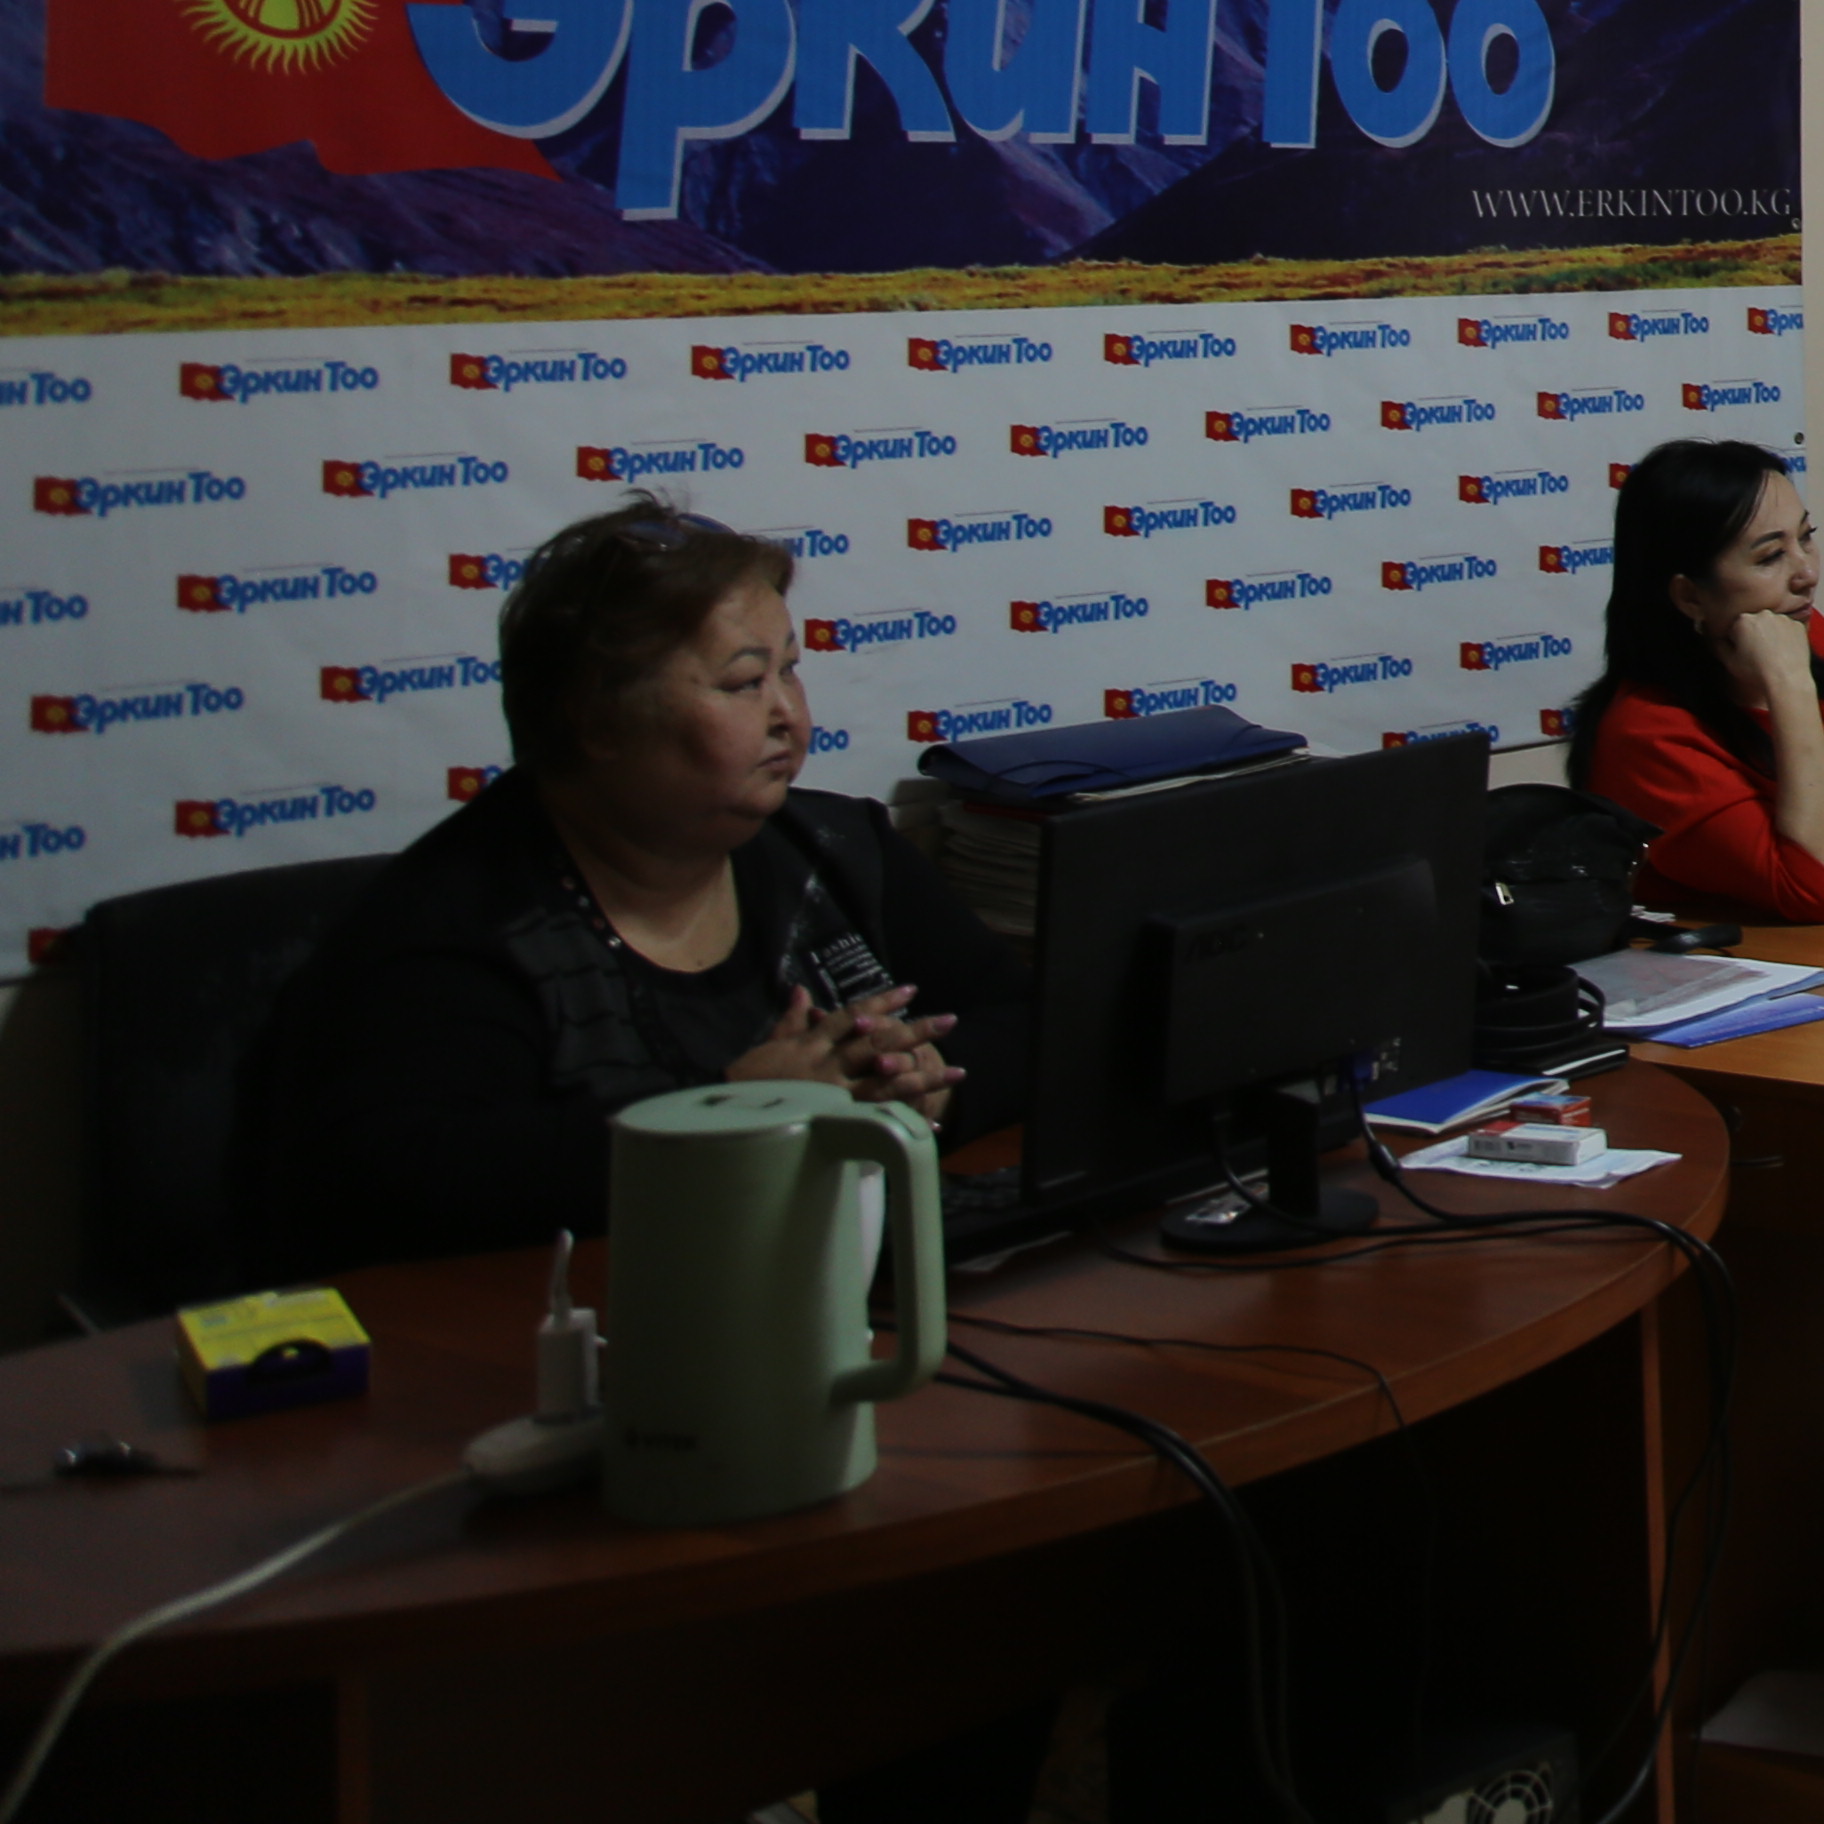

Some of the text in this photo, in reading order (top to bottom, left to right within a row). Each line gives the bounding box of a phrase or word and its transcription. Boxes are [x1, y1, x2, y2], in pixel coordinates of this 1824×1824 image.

[1471, 188, 1792, 218] WWW.ERKINTOO.KG
[1314, 324, 1411, 355] Эркин Тоо
[1481, 318, 1569, 347] Эркин Тоо
[1631, 313, 1708, 341] Эркин Тоо
[724, 346, 850, 381] Эркин Тоо
[937, 338, 1053, 371] Эркин Тоо
[1131, 334, 1236, 366] Эркин Тоо
[30, 373, 91, 405] Тоо
[222, 362, 378, 403] Эркин Тоо
[486, 353, 626, 390] Эркин Тоо
[1560, 391, 1644, 418] Эркин Тоо
[1702, 382, 1781, 410] Эркин Тоо
[1231, 410, 1331, 442] Эркин Тоо
[1405, 400, 1496, 430] Эркин Тоо
[836, 431, 956, 467] Эркин Тоо
[1039, 423, 1148, 457] Эркин Тоо
[361, 457, 508, 498] Эркин Тоо
[611, 444, 743, 482] Эркин Тоо
[79, 473, 244, 516] Эркин Тоо
[1316, 486, 1412, 518] Эркин Тоо
[1483, 472, 1568, 502] Эркин Тоо
[937, 514, 1052, 552] Эркин Тоо
[1131, 502, 1236, 538] Эркин Тоо
[805, 530, 849, 557] Тоо
[220, 568, 376, 613] Эркин Тоо
[1406, 557, 1497, 590] Эркин Тоо
[25, 590, 88, 625] Тоо
[1232, 574, 1332, 609] Эркин Тоо
[836, 612, 957, 651] Эркин Тоо
[1038, 595, 1149, 633] Эркин Тоо
[1484, 636, 1571, 669] Эркин Тоо
[359, 666, 454, 702] Эркин
[1317, 656, 1412, 691] Эркин Тоо
[77, 685, 243, 732] Эркин Тоо
[1132, 681, 1237, 716] Эркин Тоо
[937, 702, 1052, 742] Эркин Тоо
[218, 787, 374, 837] Эркин Тоо
[22, 824, 84, 857] Тоо
